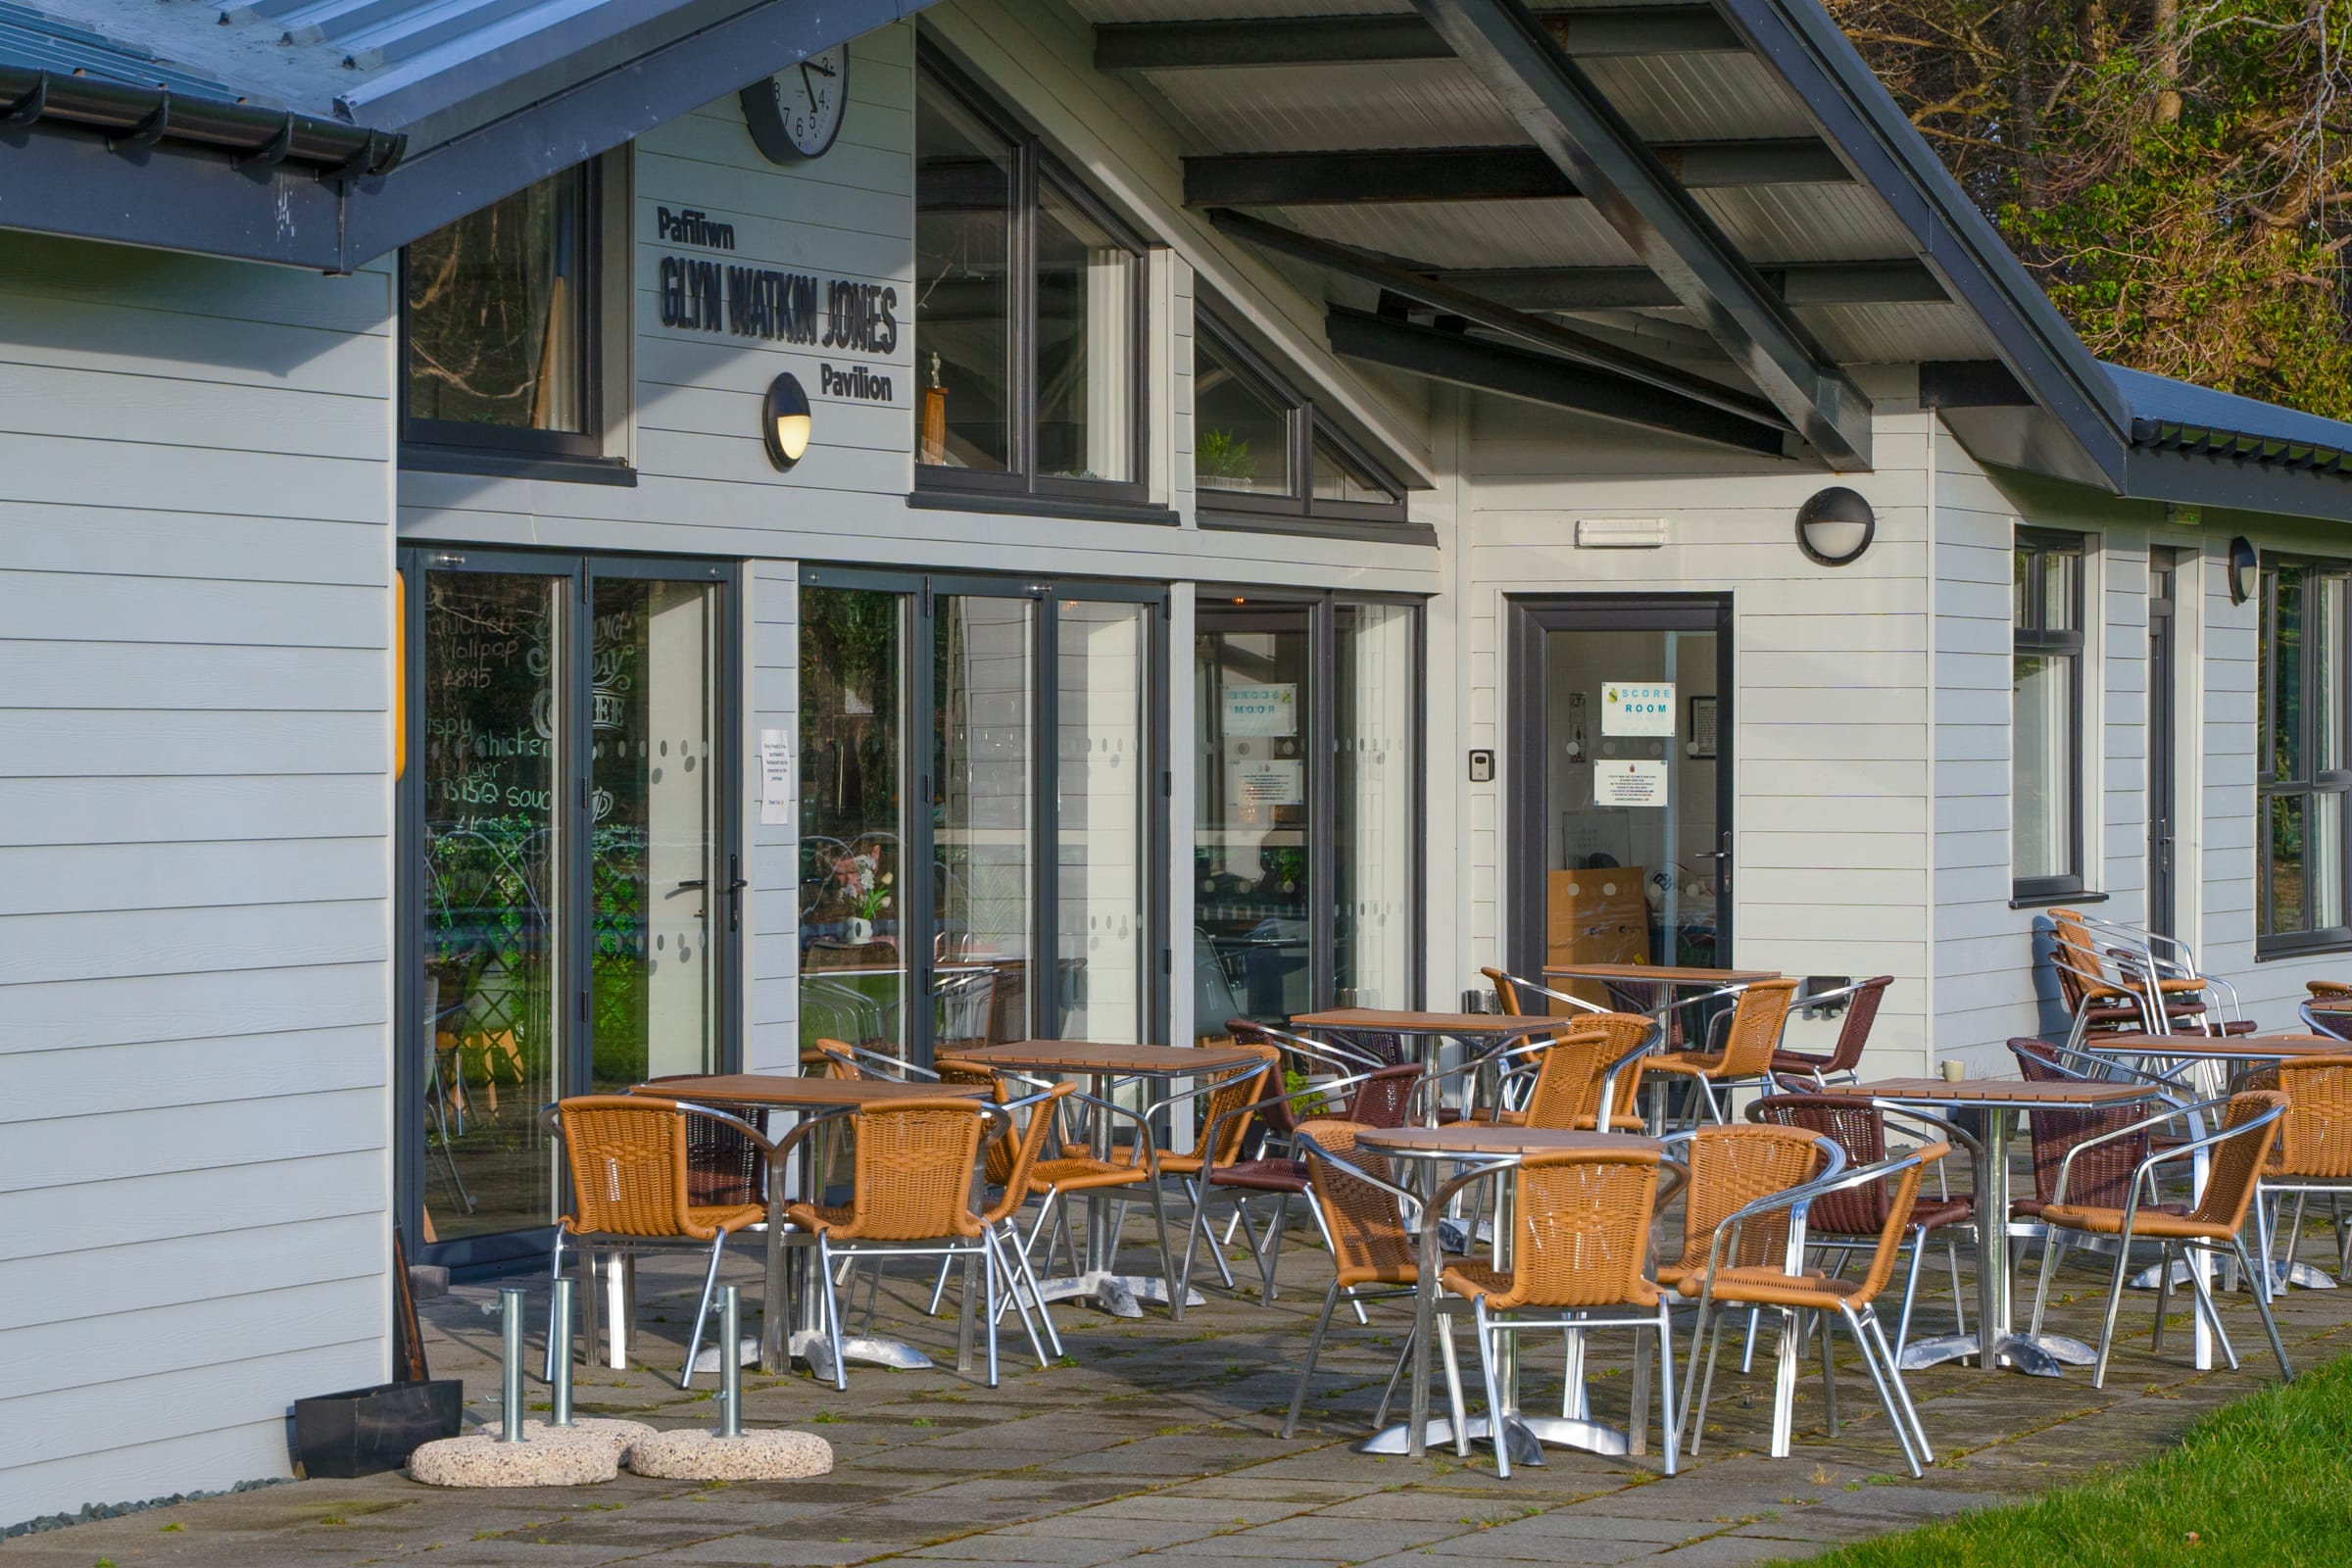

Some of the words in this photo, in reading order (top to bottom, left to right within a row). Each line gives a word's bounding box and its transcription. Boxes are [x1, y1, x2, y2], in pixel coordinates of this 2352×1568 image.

[819, 89, 825, 109] 4
[784, 108, 791, 125] 7
[809, 110, 816, 129] 5
[797, 118, 803, 137] 6
[658, 206, 735, 250] Pafiliwn
[660, 256, 723, 333] GLYN
[728, 265, 817, 347] WATKIN
[821, 279, 898, 355] JONES
[820, 363, 893, 402] Pavilion
[1622, 689, 1671, 698] SCORE
